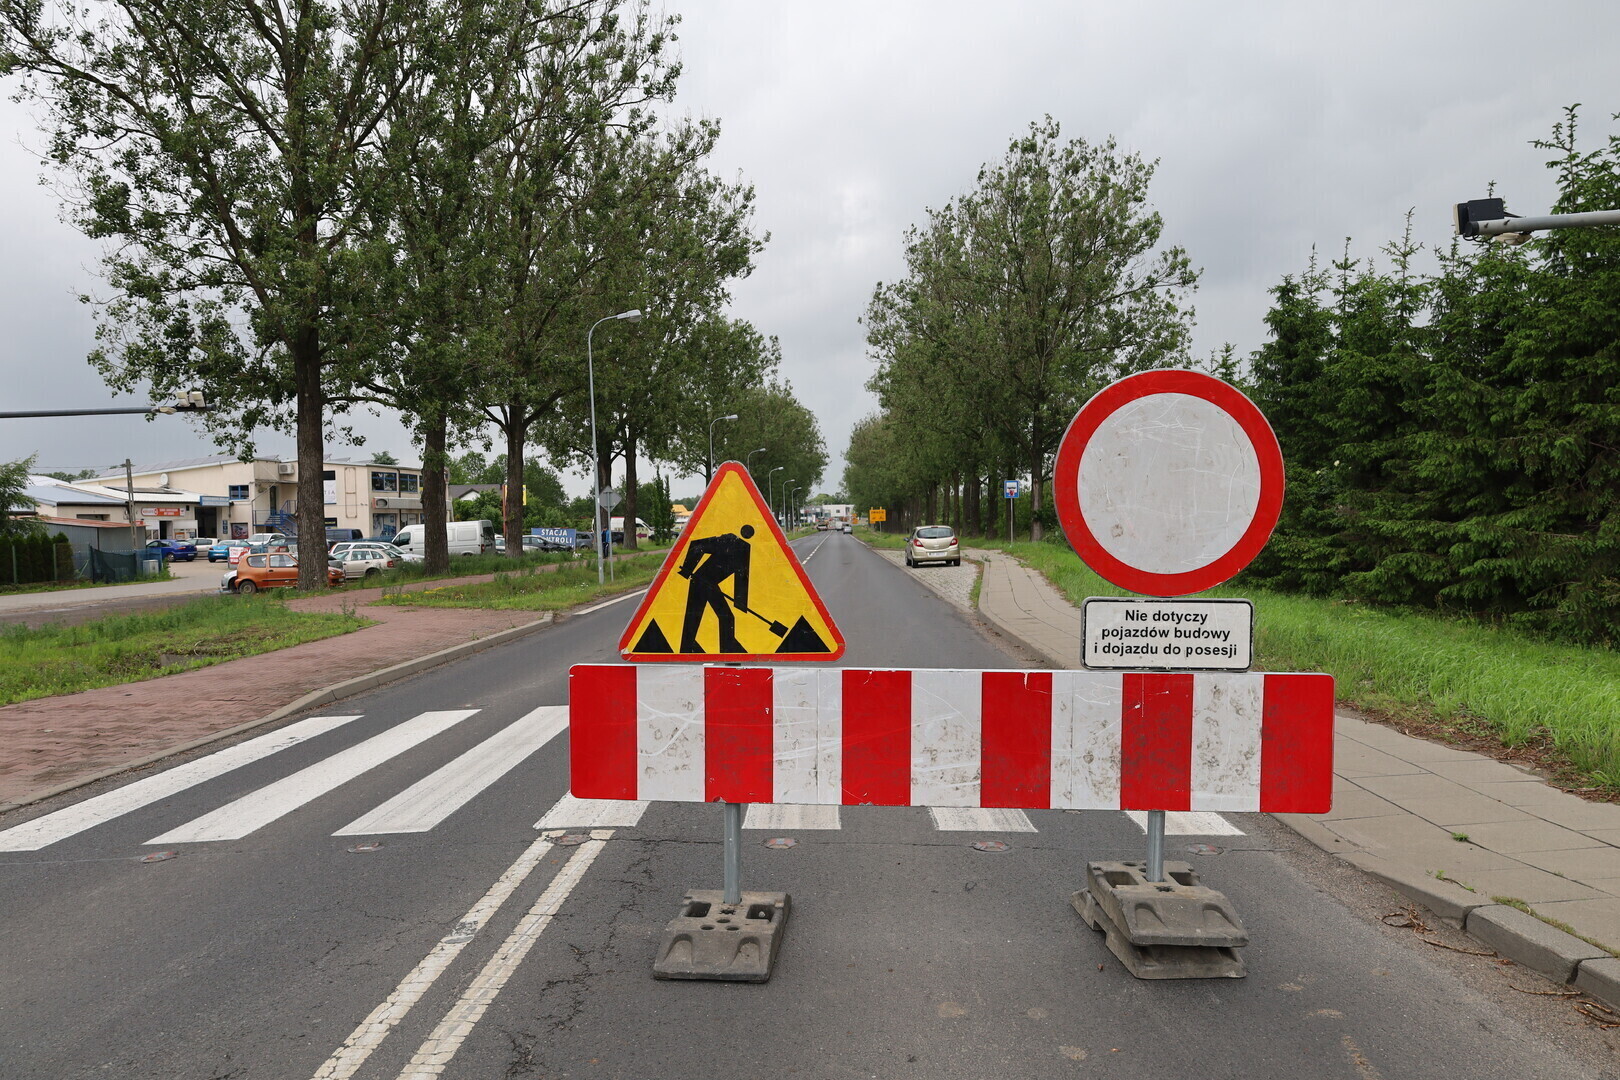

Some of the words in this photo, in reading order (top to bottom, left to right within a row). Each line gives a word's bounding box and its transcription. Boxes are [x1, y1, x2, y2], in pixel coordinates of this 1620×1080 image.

[1125, 609, 1148, 621] Nie
[1152, 610, 1208, 625] dotyczy
[1101, 627, 1170, 640] pojazdów
[1174, 627, 1231, 642] budowy
[1094, 642, 1098, 654] i
[1102, 643, 1158, 656] dojazdu
[1163, 643, 1181, 655] do
[1185, 644, 1237, 658] posesji
